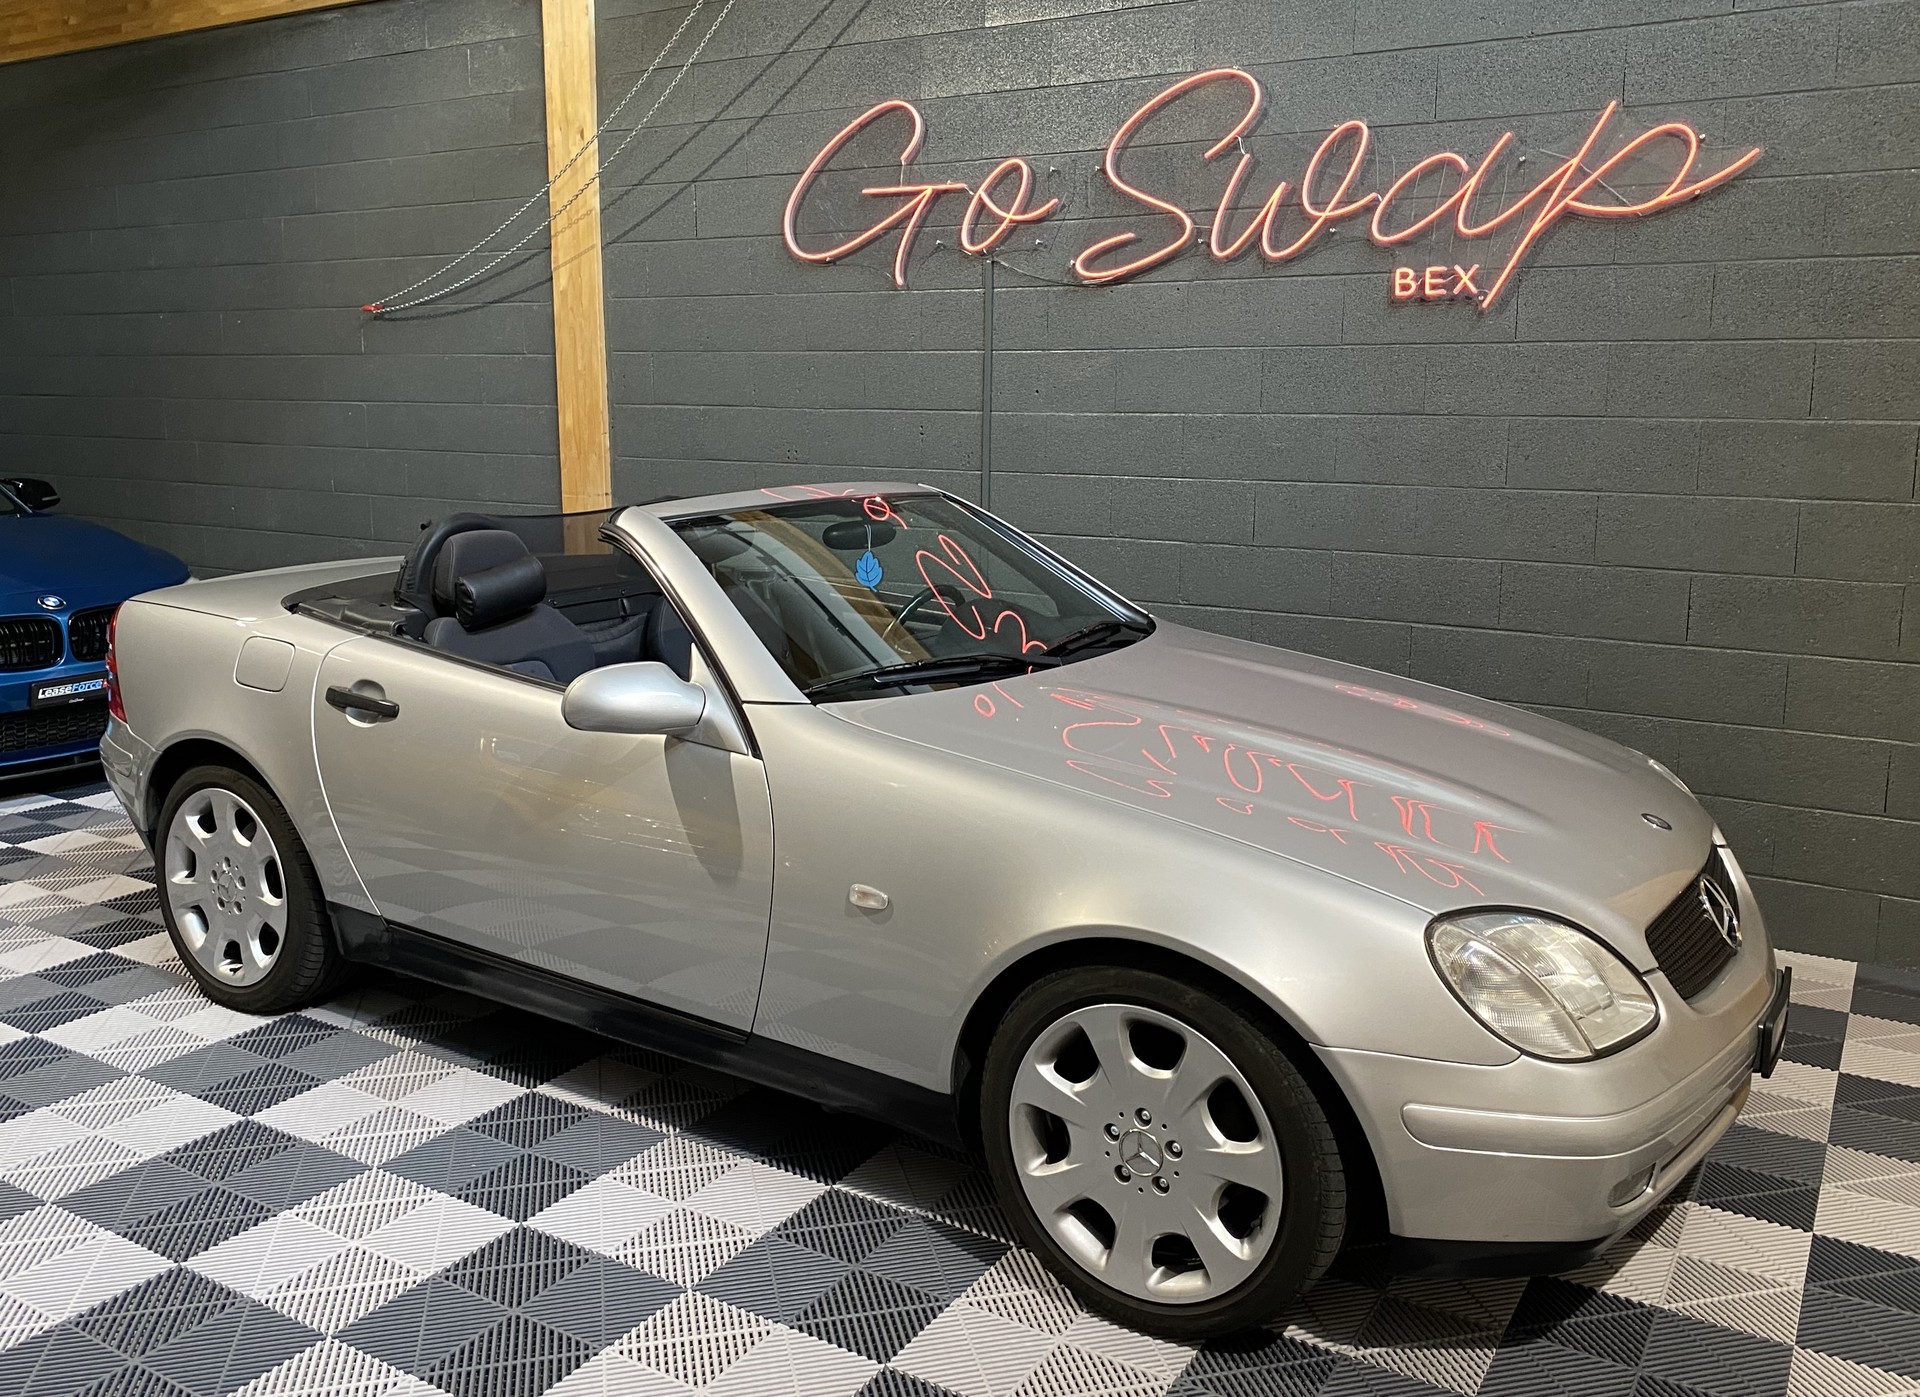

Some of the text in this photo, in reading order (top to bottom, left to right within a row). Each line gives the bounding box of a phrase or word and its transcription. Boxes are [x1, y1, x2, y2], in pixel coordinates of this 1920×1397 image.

[782, 67, 1762, 310] Go Swap
[1393, 263, 1480, 297] BEX
[38, 679, 103, 699] LeaseForce
